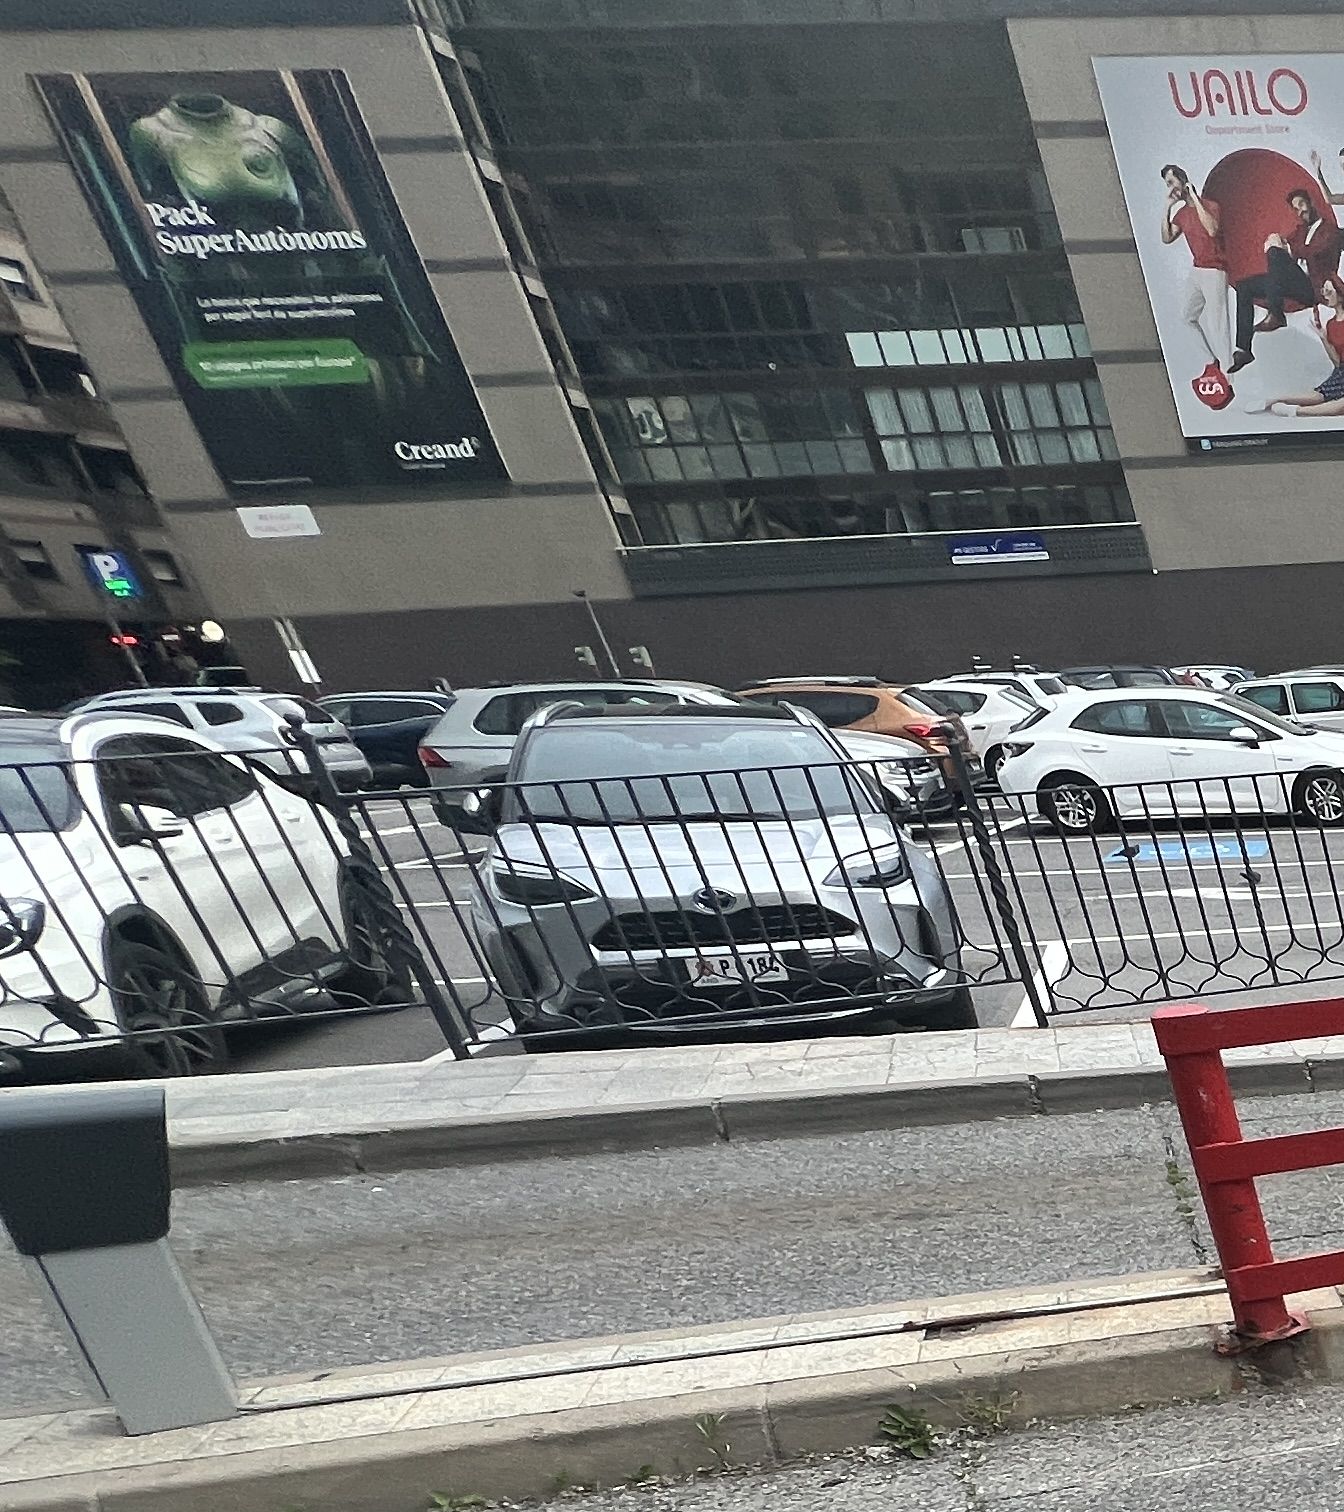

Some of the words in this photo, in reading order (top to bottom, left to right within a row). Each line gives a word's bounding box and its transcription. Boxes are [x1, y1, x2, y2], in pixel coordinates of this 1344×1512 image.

[1205, 125, 1262, 135] Department
[1265, 124, 1289, 134] Store
[144, 201, 217, 227] Pack
[156, 226, 367, 259] SuperAutònoms
[394, 437, 476, 461] Creand
[93, 554, 119, 580] P
